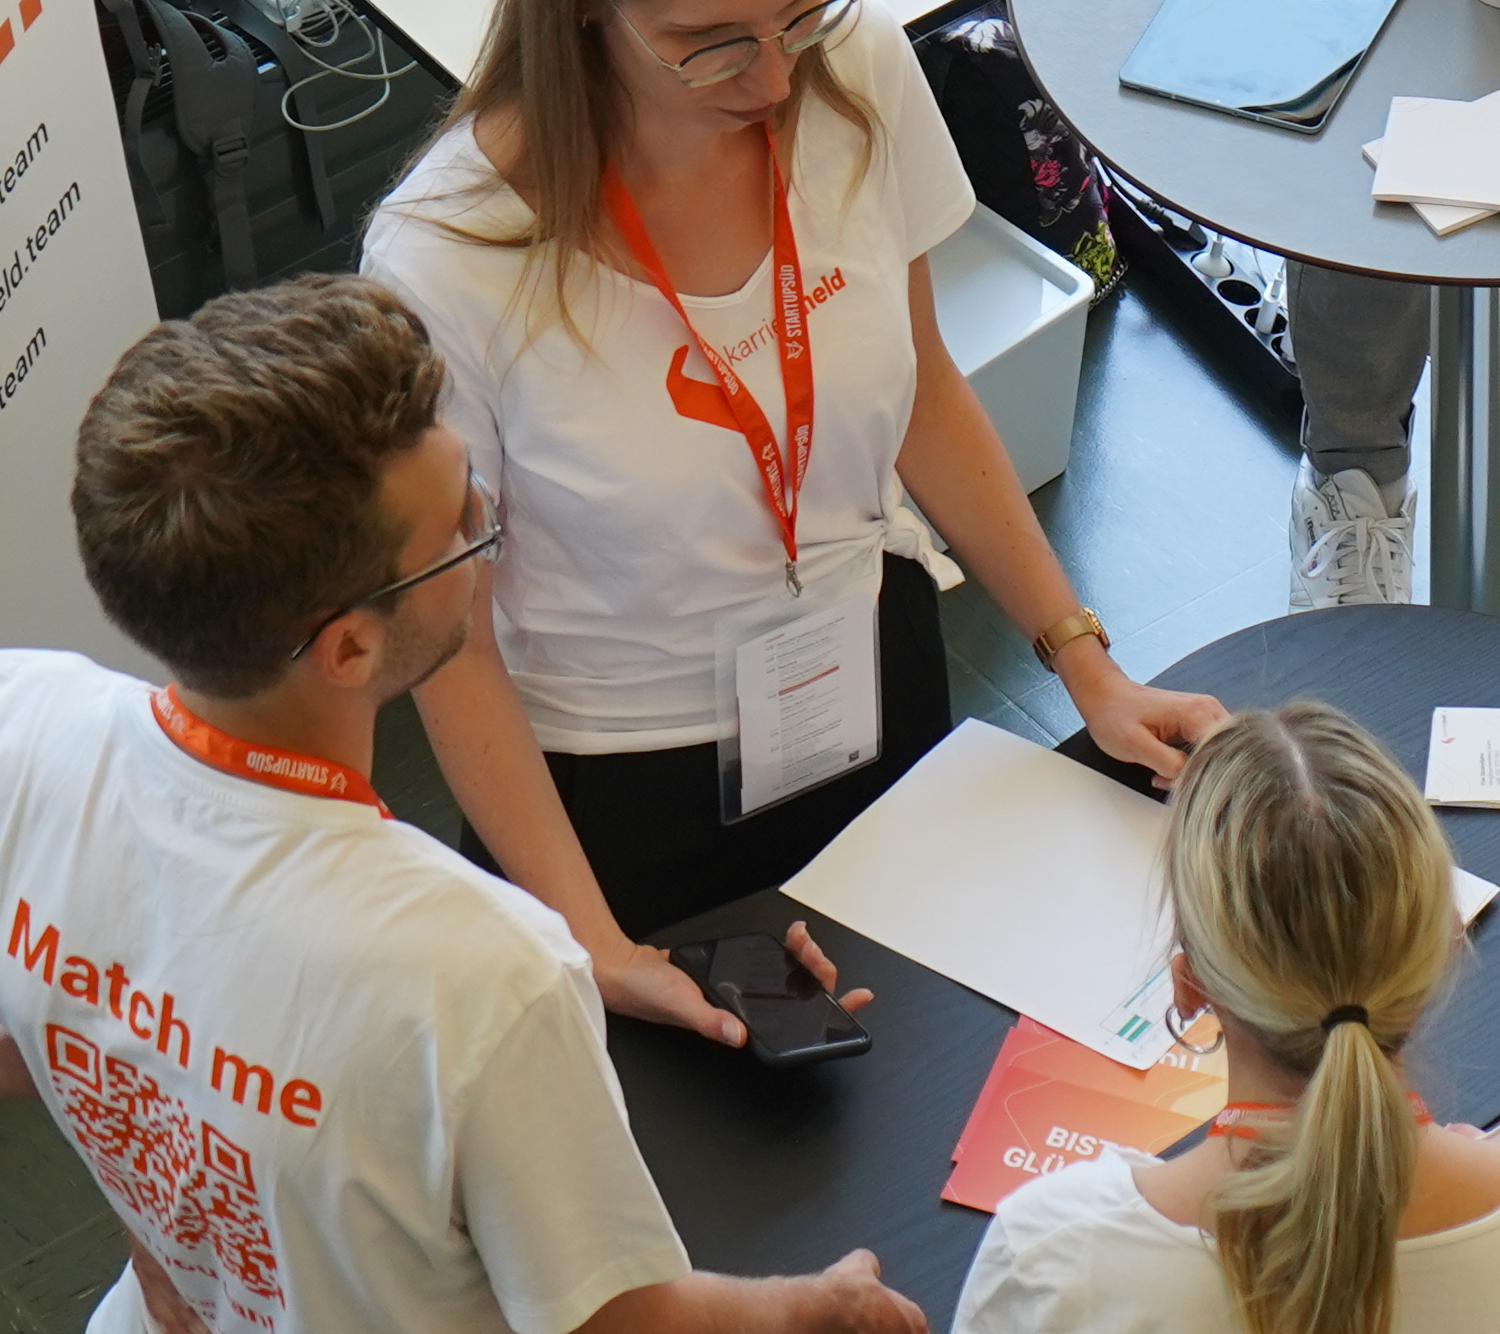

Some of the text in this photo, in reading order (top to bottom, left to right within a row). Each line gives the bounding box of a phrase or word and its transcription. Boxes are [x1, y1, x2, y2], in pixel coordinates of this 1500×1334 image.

[781, 265, 803, 337] STARTUPSÜD
[246, 750, 329, 785] STARTUPSÜD
[7, 897, 324, 1128] Match me
